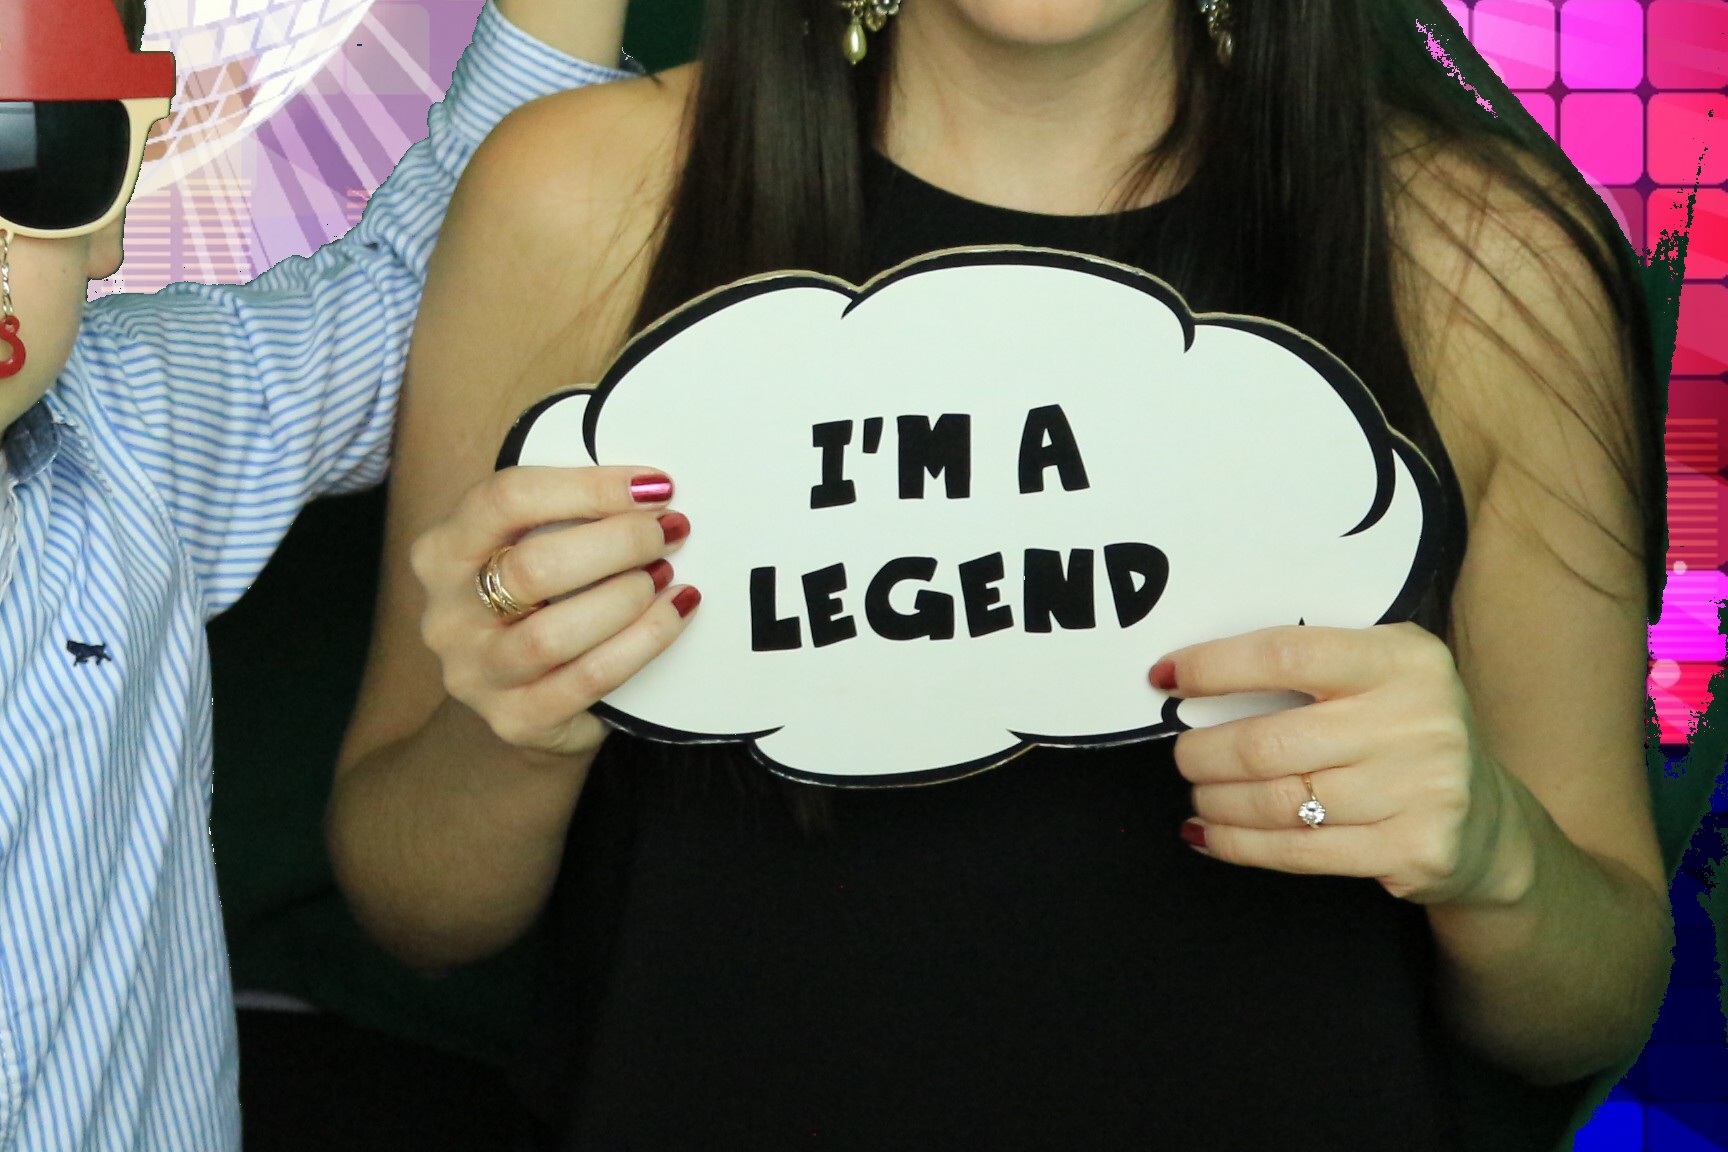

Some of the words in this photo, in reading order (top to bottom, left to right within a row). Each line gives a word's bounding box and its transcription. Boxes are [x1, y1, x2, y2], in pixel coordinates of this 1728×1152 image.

[810, 413, 971, 509] I'M
[1018, 404, 1090, 494] A
[749, 541, 1170, 652] LEGEND
